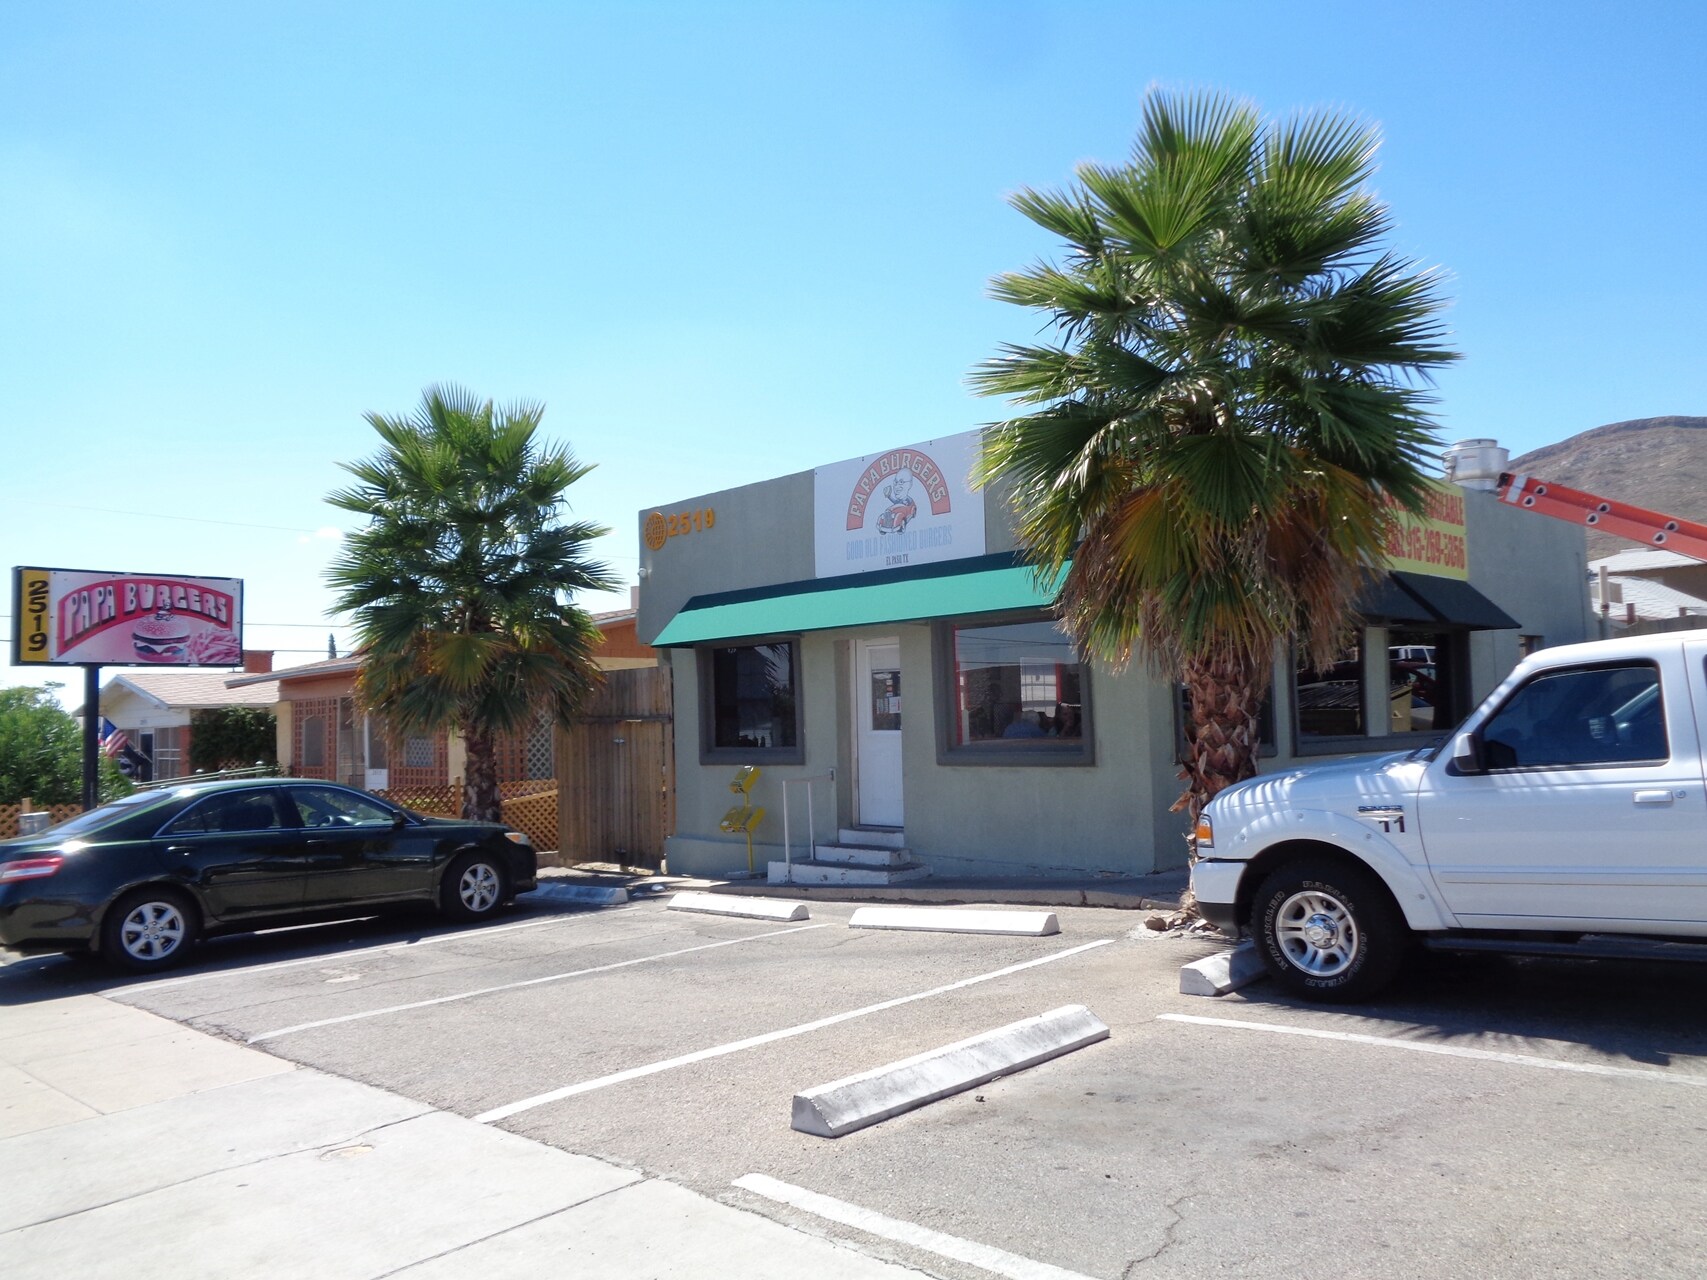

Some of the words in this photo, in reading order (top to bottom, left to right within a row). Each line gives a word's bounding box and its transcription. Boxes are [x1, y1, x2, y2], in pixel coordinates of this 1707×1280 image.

[851, 470, 880, 517] PAPA
[880, 453, 946, 502] BURGERS
[668, 507, 715, 538] 2519
[865, 537, 878, 558] OLD
[919, 525, 953, 550] BURGERS
[28, 580, 49, 652] 2519
[64, 585, 116, 645] PAPA
[123, 583, 228, 625] BURGERS
